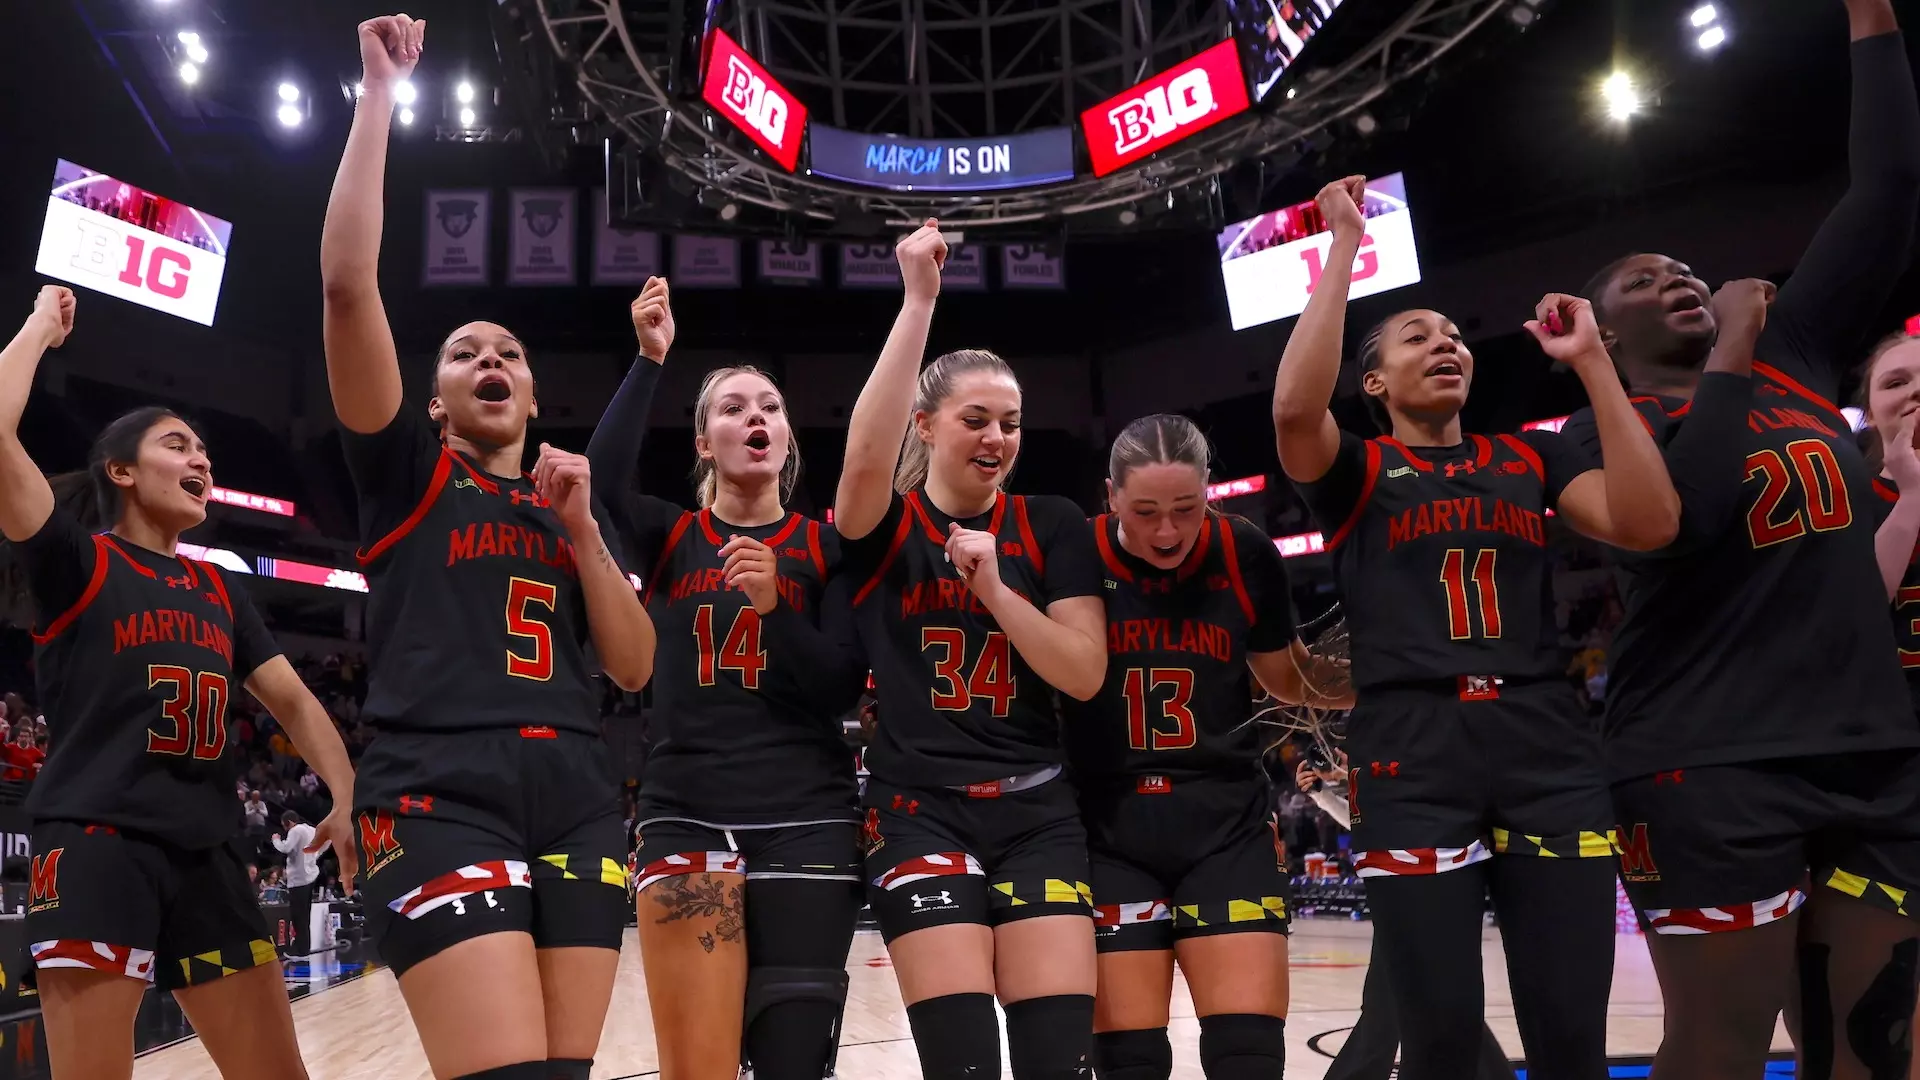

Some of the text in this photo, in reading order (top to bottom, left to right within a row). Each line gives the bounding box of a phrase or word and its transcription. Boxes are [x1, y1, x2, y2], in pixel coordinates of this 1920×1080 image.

[866, 144, 1011, 174] MARCH IS ON
[1387, 496, 1546, 551] MARYLAND
[1742, 438, 1853, 549] 20
[447, 522, 581, 580] MARYLAN
[1440, 548, 1502, 640] 11
[505, 576, 557, 682] 5
[692, 603, 767, 690] 14
[921, 626, 1017, 717] 34
[1107, 619, 1232, 663] ARYLAND
[147, 664, 228, 760] 30
[1122, 667, 1198, 751] 13
